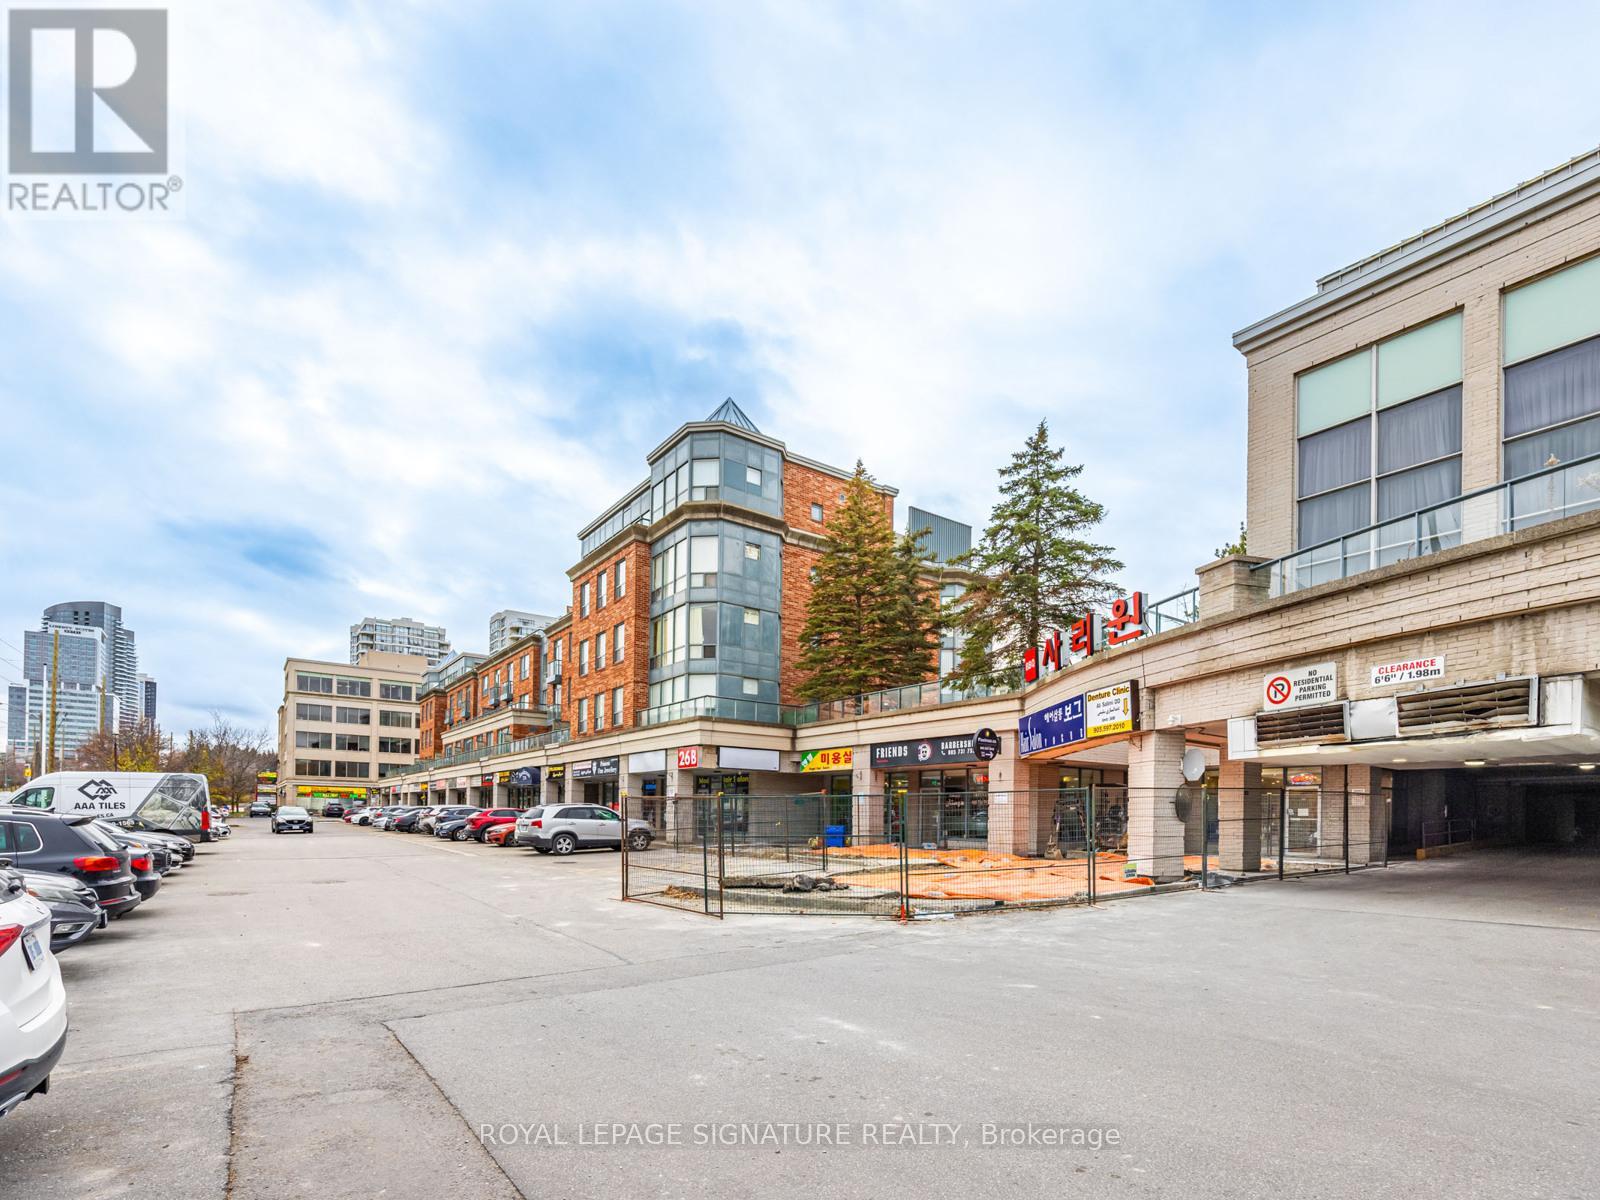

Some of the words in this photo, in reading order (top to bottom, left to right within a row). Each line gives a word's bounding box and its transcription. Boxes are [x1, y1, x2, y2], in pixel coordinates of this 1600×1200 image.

[1042, 591, 1144, 672] 사리원
[1378, 658, 1436, 675] CLEARANCE
[1293, 674, 1334, 686] RESIDENTIAL
[1408, 668, 1441, 680] 1.98m
[1088, 692, 1110, 702] Denture
[1112, 686, 1130, 696] Clinic
[1294, 690, 1331, 702] PERMITTED
[1299, 684, 1327, 694] PARKING
[1064, 700, 1082, 722] 보그
[678, 750, 697, 766] 26B
[820, 750, 852, 765] 미용실
[876, 746, 908, 759] FRIENDS
[98, 802, 126, 810] TILES
